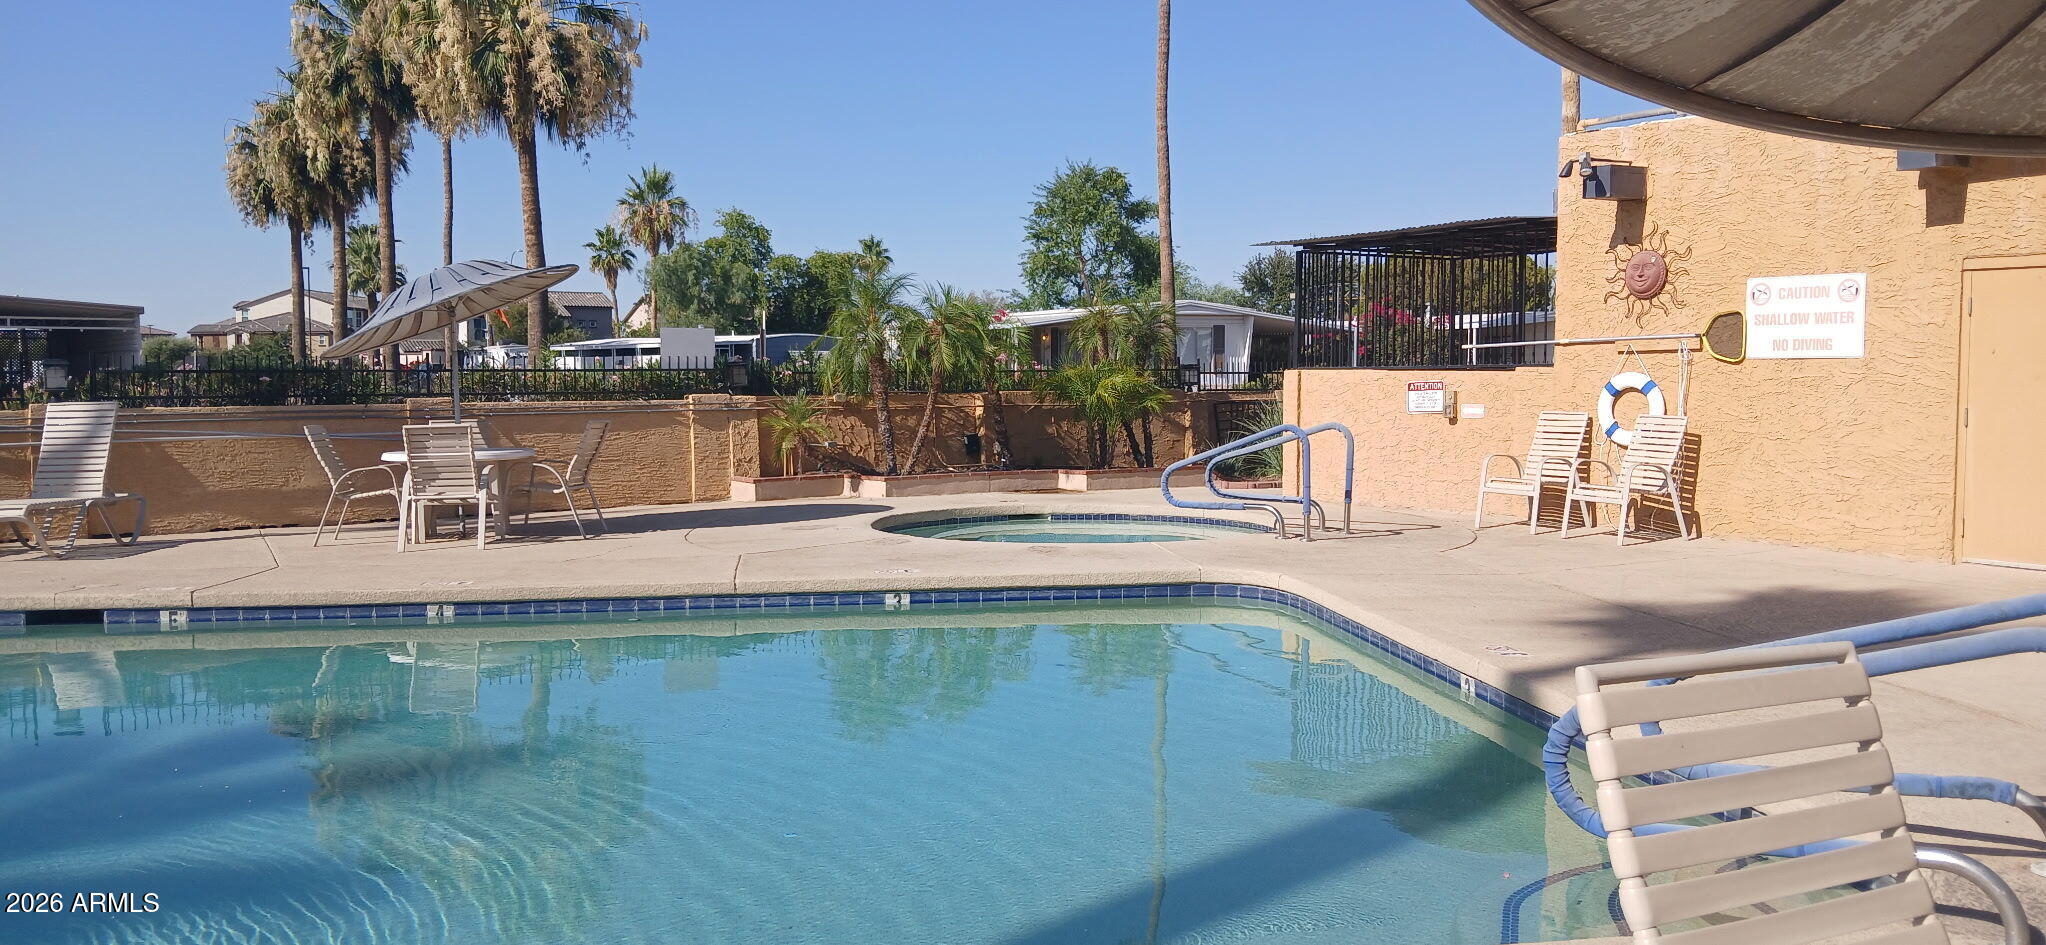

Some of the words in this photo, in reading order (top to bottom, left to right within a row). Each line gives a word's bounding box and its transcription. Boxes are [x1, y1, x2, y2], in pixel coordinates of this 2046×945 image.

[1779, 286, 1830, 300] CAUTION
[1754, 312, 1810, 326] SHALLOW
[1815, 311, 1855, 325] WATER
[1772, 339, 1788, 352] NO
[1793, 338, 1833, 351] DIVING
[1409, 382, 1443, 391] ATTENTION
